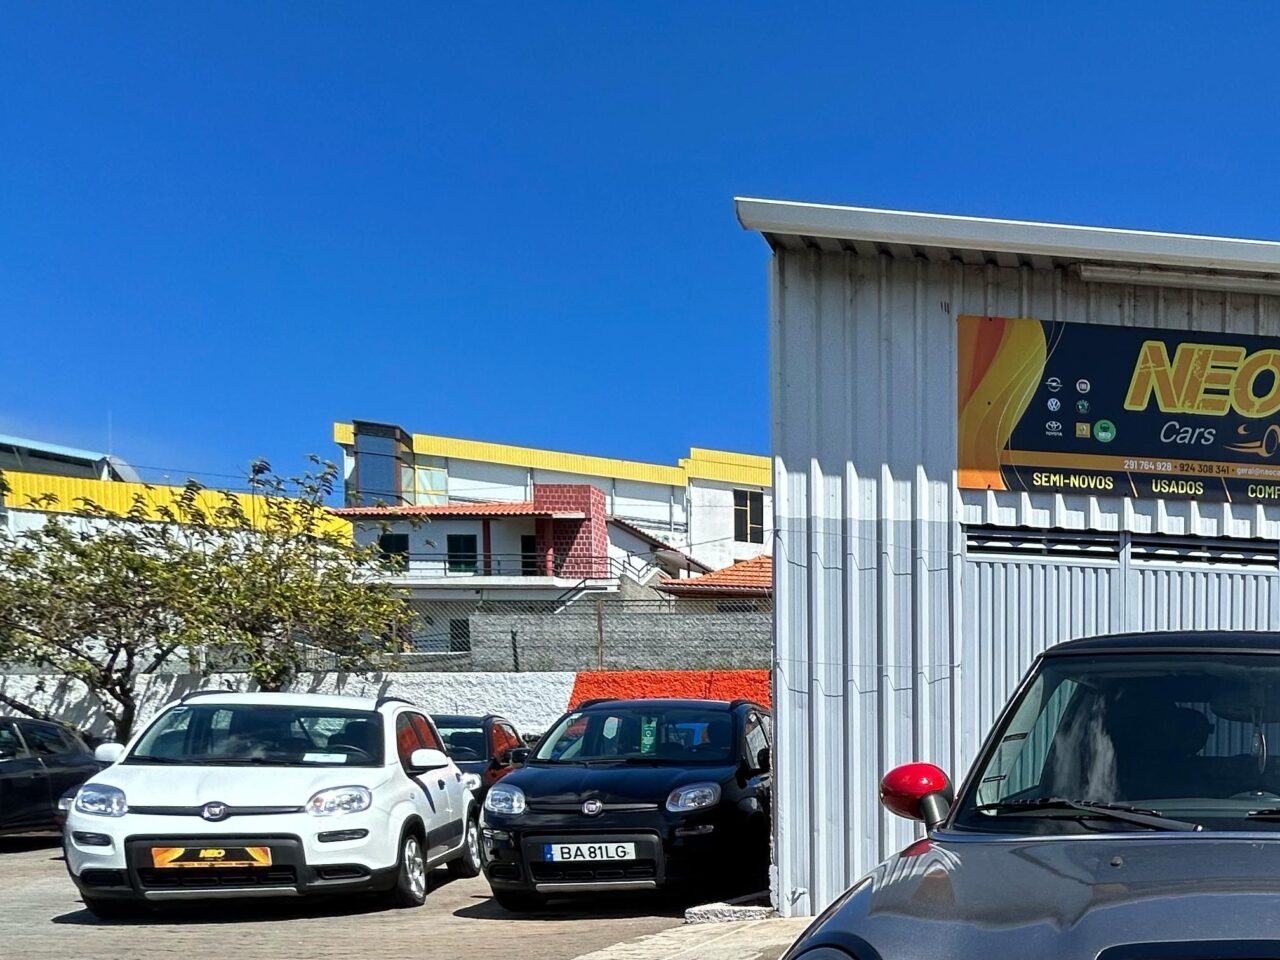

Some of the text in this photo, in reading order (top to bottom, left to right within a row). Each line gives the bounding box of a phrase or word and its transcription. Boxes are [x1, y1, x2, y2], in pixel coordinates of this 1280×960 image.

[1160, 420, 1216, 445] Cars
[1139, 460, 1155, 470] 764
[1156, 461, 1172, 471] 928
[1179, 464, 1196, 473] 924
[1199, 465, 1213, 474] 308
[1215, 466, 1230, 475] 341
[1033, 472, 1113, 489] SEMI-NOVOS
[1152, 479, 1204, 495] USADOS
